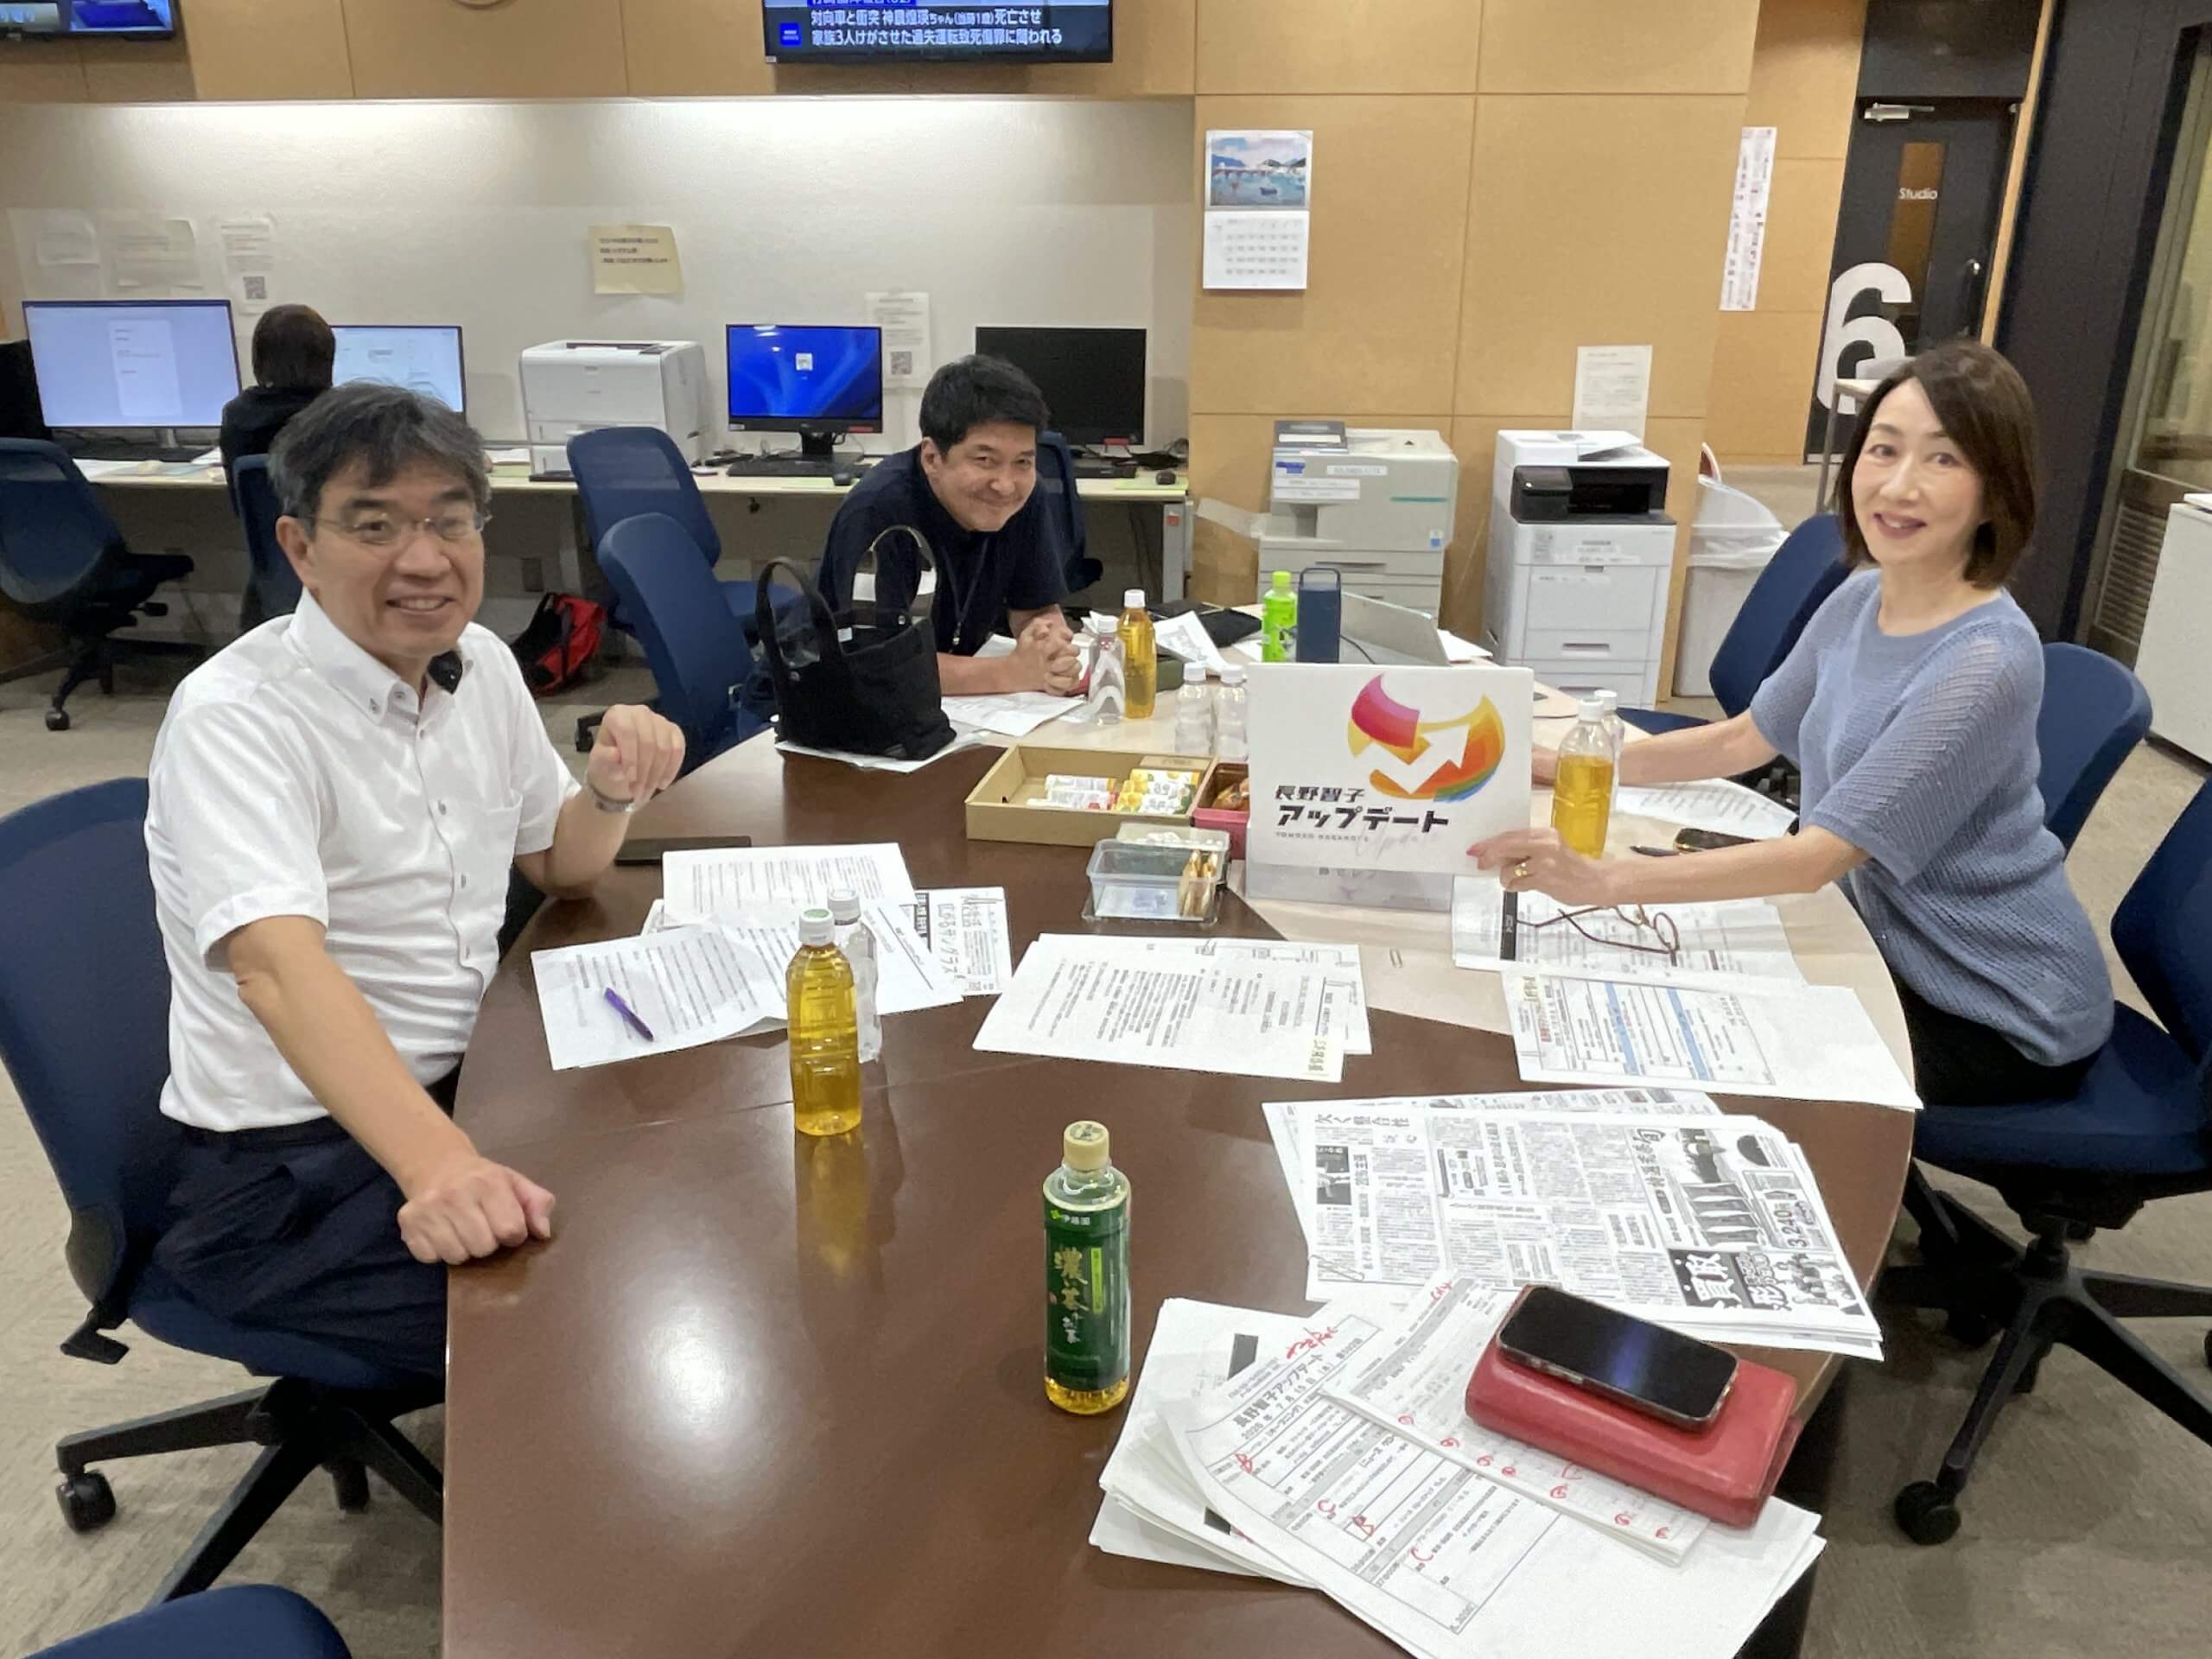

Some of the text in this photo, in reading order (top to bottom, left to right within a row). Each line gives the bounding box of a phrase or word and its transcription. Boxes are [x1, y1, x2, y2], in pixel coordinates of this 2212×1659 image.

[1898, 187, 1938, 201] Studio
[1816, 262, 1913, 415] 6
[1274, 785, 1365, 804] 長野智子
[1276, 804, 1450, 834] アップデート
